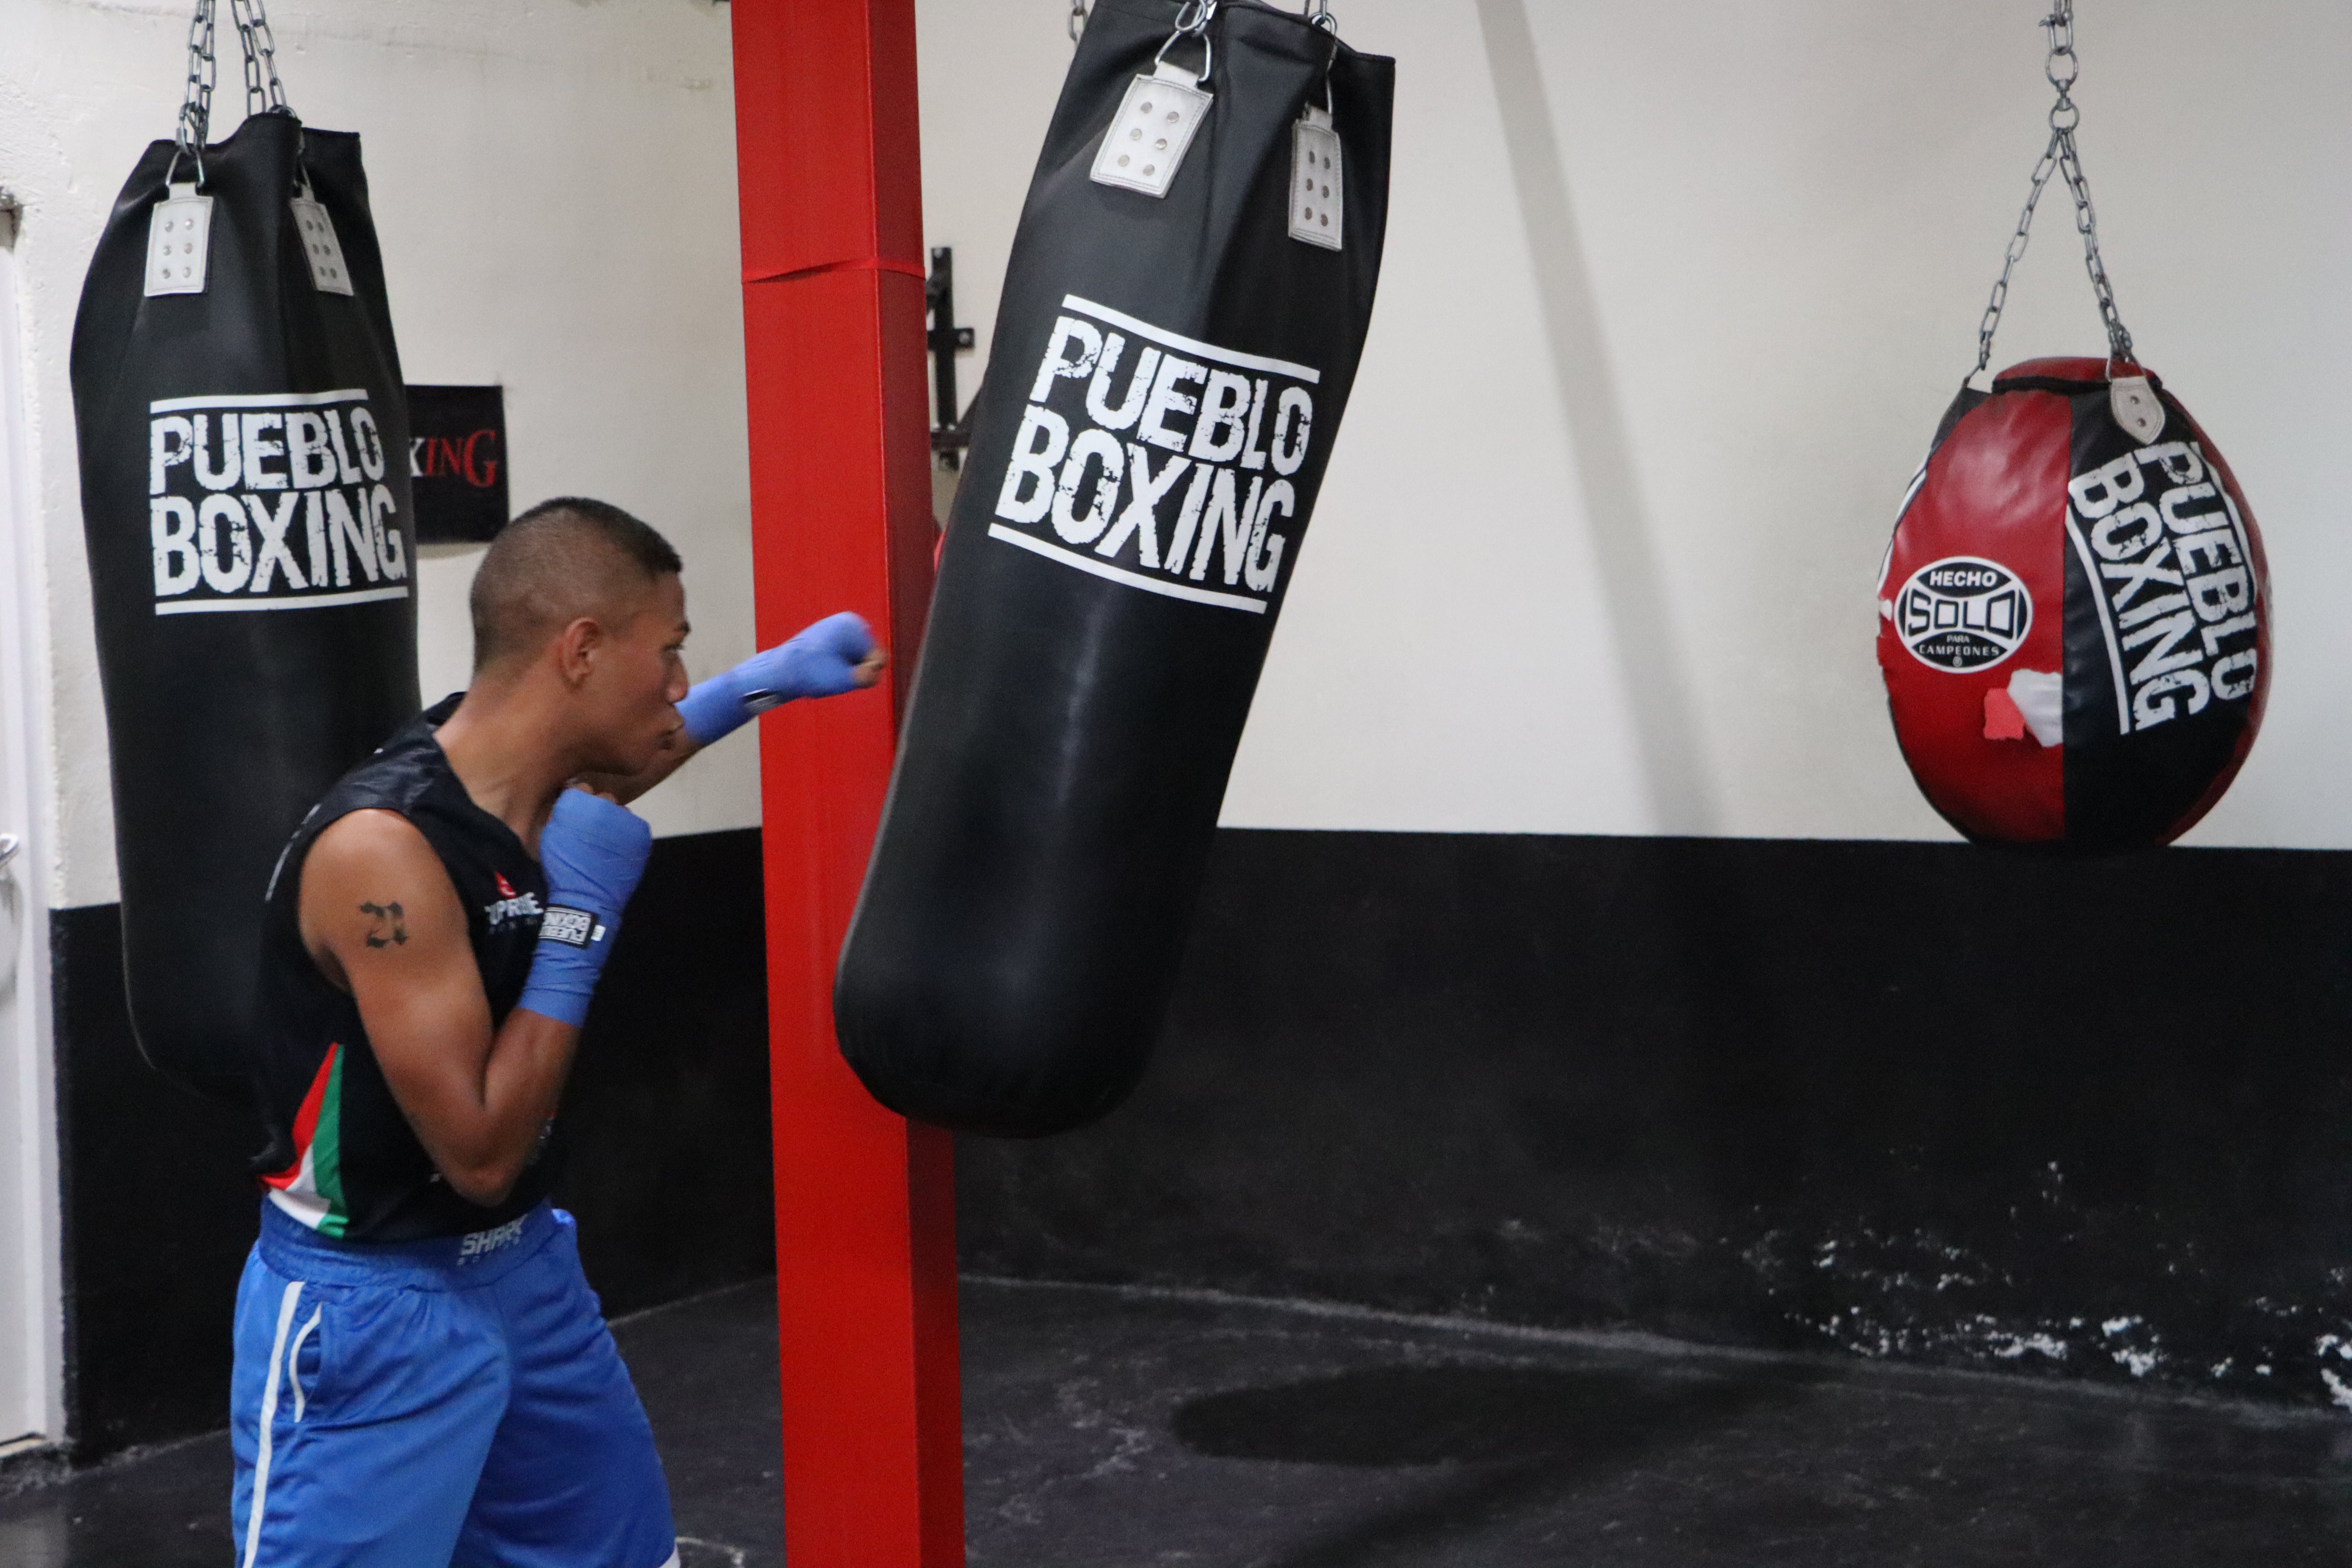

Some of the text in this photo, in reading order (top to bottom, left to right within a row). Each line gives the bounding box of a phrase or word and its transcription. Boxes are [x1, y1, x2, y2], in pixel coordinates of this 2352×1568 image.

[1029, 316, 1312, 475] PUEBLO
[150, 407, 385, 495] PUEBLO
[995, 404, 1295, 593] BOXING
[150, 484, 408, 596] BOXING
[1929, 571, 1997, 587] HECHO
[2133, 441, 2258, 700] PUEBLO
[1908, 588, 2016, 639] SOLO
[1946, 635, 1970, 643] PARA
[2068, 452, 2210, 731] BOXING
[1919, 644, 1999, 656] CAMPEONES
